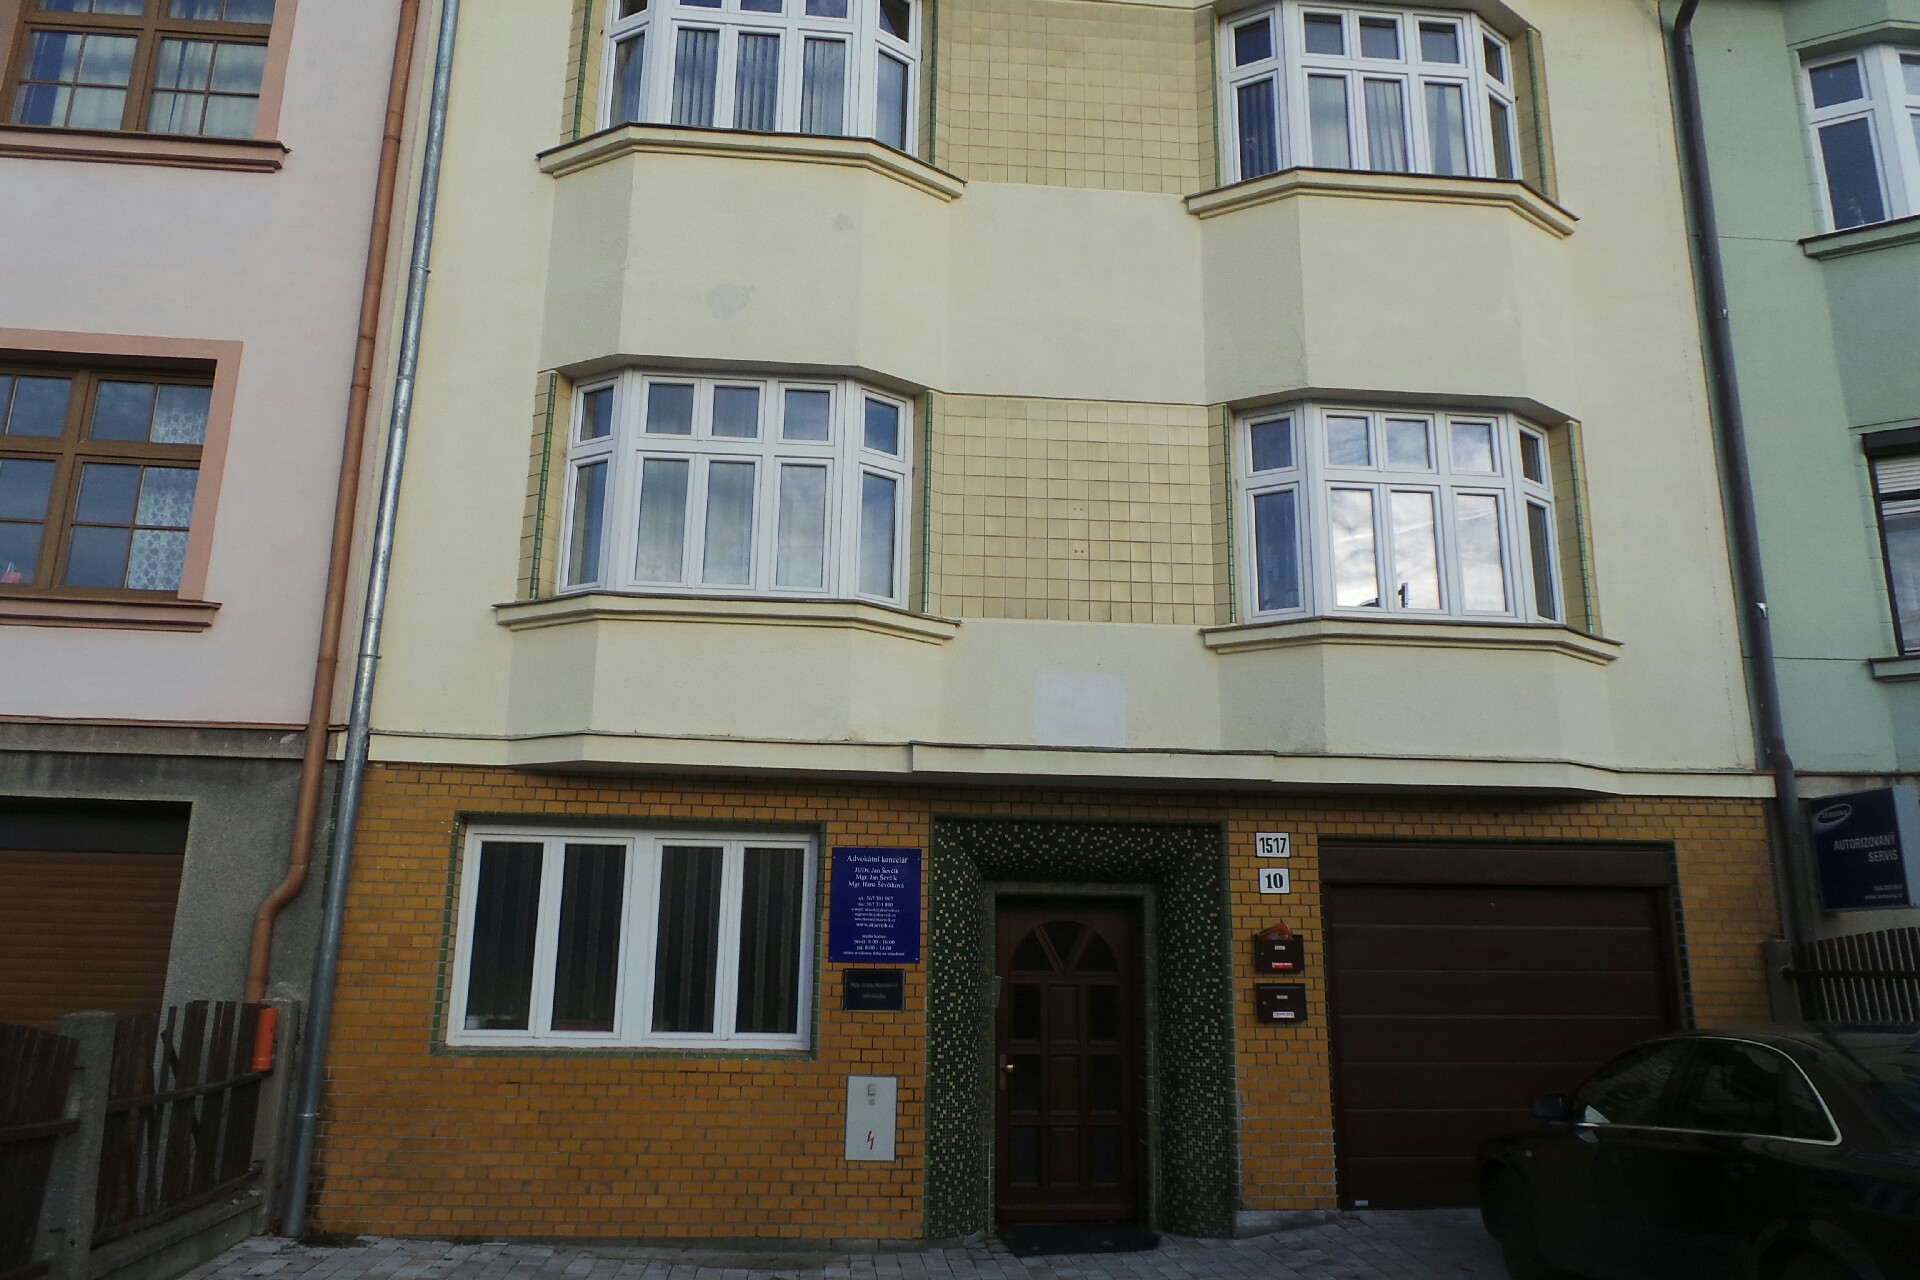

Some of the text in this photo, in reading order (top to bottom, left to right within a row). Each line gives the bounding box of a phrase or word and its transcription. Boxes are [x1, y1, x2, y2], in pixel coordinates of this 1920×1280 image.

[1259, 837, 1287, 854] 1517
[1834, 832, 1895, 850] AUTORIZOVANÝ
[846, 855, 908, 864] Advokátní kancelář
[1868, 849, 1898, 862] SERVIS
[1265, 873, 1284, 889] 10
